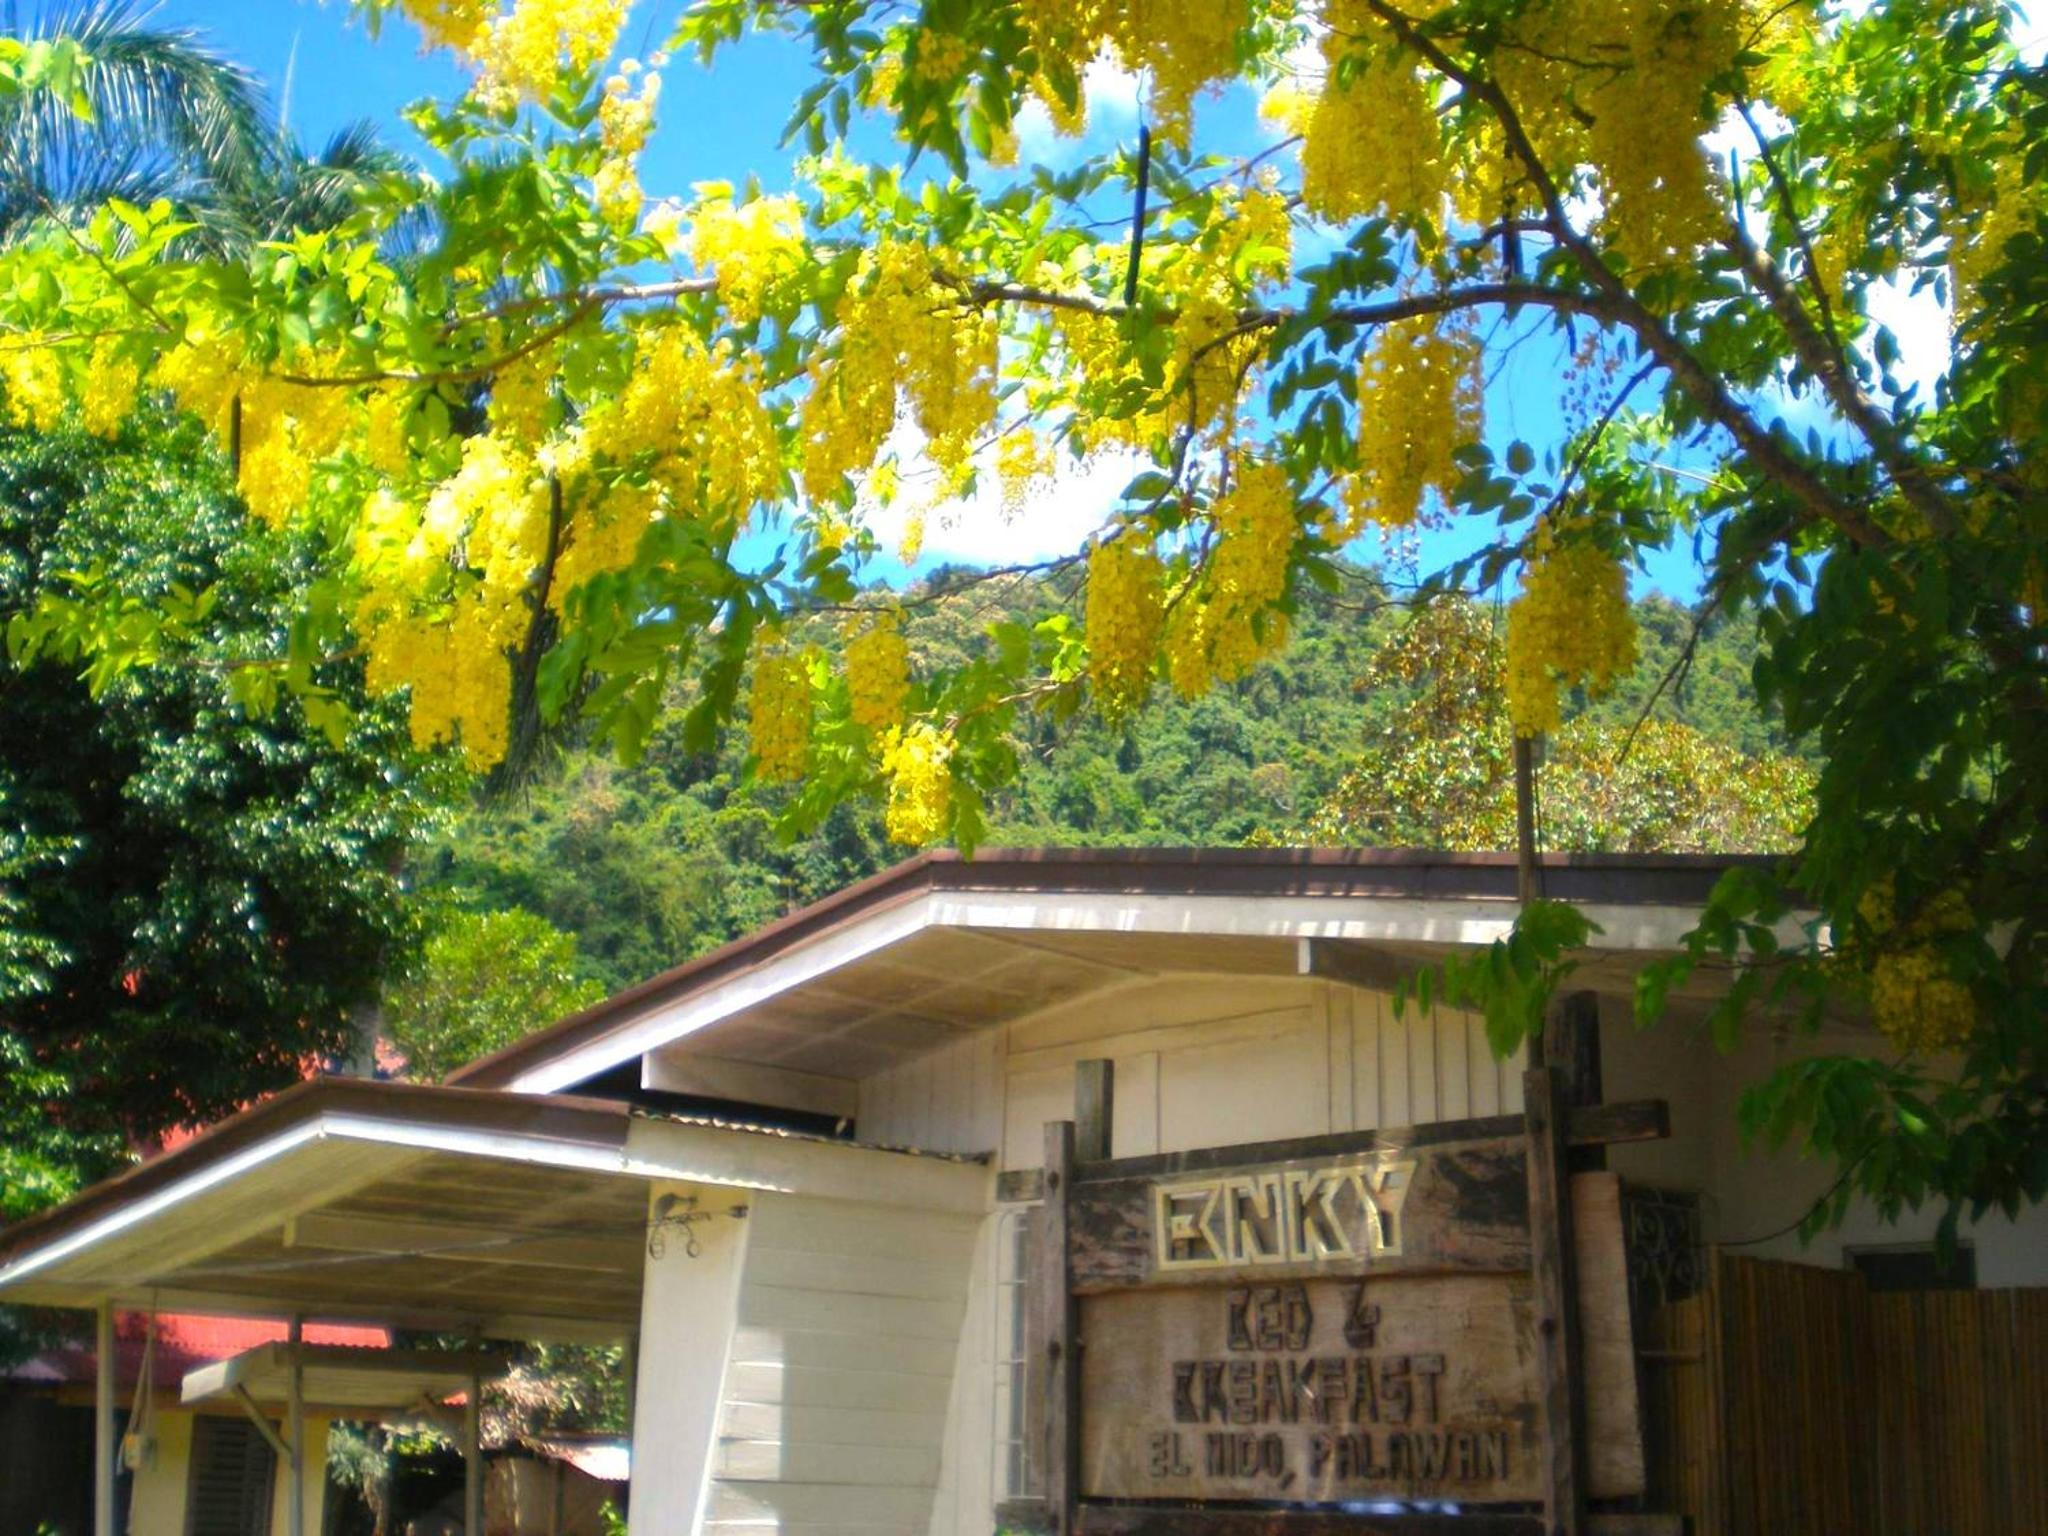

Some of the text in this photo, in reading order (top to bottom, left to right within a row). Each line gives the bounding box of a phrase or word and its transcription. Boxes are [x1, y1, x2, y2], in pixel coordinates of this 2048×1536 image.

[1172, 1354, 1446, 1425] BREAKFAST
[1150, 1431, 1192, 1478] EL
[1309, 1430, 1511, 1481] PALAWAN
